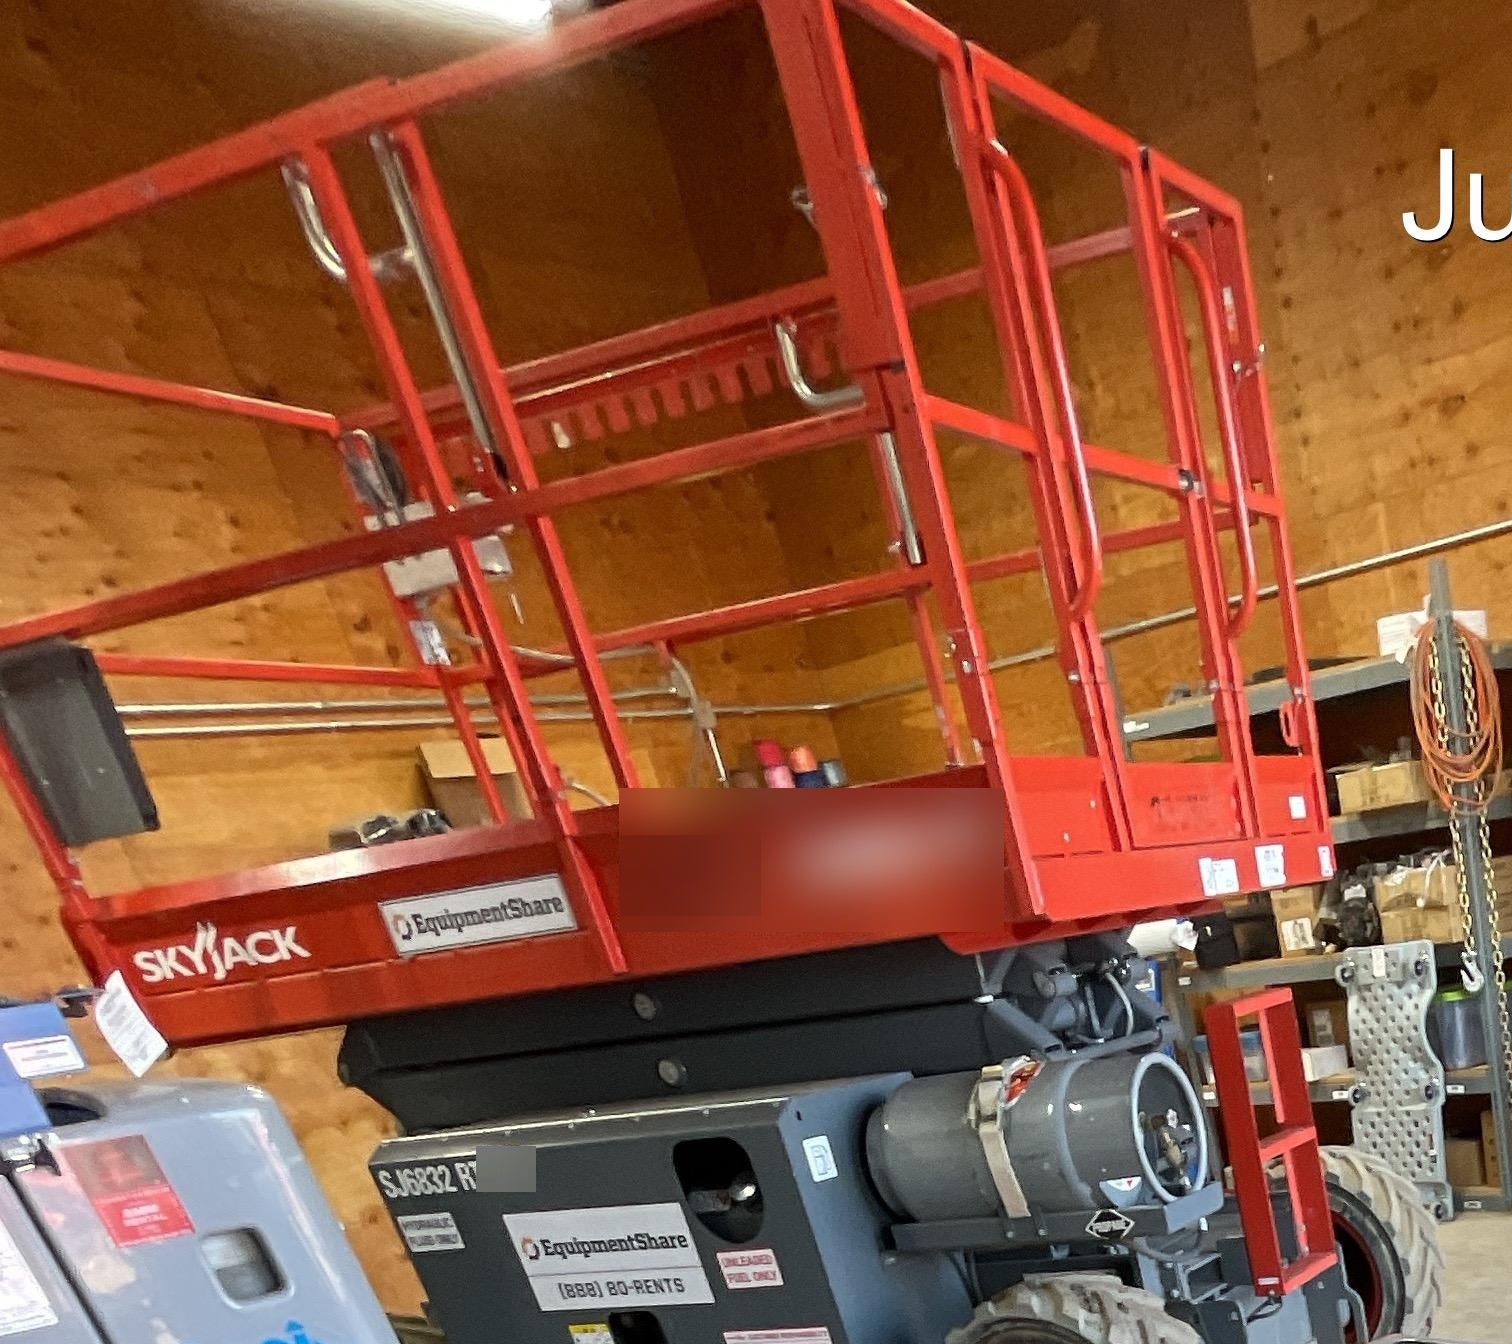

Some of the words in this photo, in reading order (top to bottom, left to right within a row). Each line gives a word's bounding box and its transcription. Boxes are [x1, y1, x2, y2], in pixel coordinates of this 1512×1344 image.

[410, 893, 566, 936] EquipmentShare
[132, 921, 312, 981] SKYJACK
[378, 1163, 459, 1199] SJ6832
[540, 1233, 689, 1261] EquipmentShare
[556, 1279, 604, 1300] (888)
[607, 1276, 686, 1297] 80-RENTS
